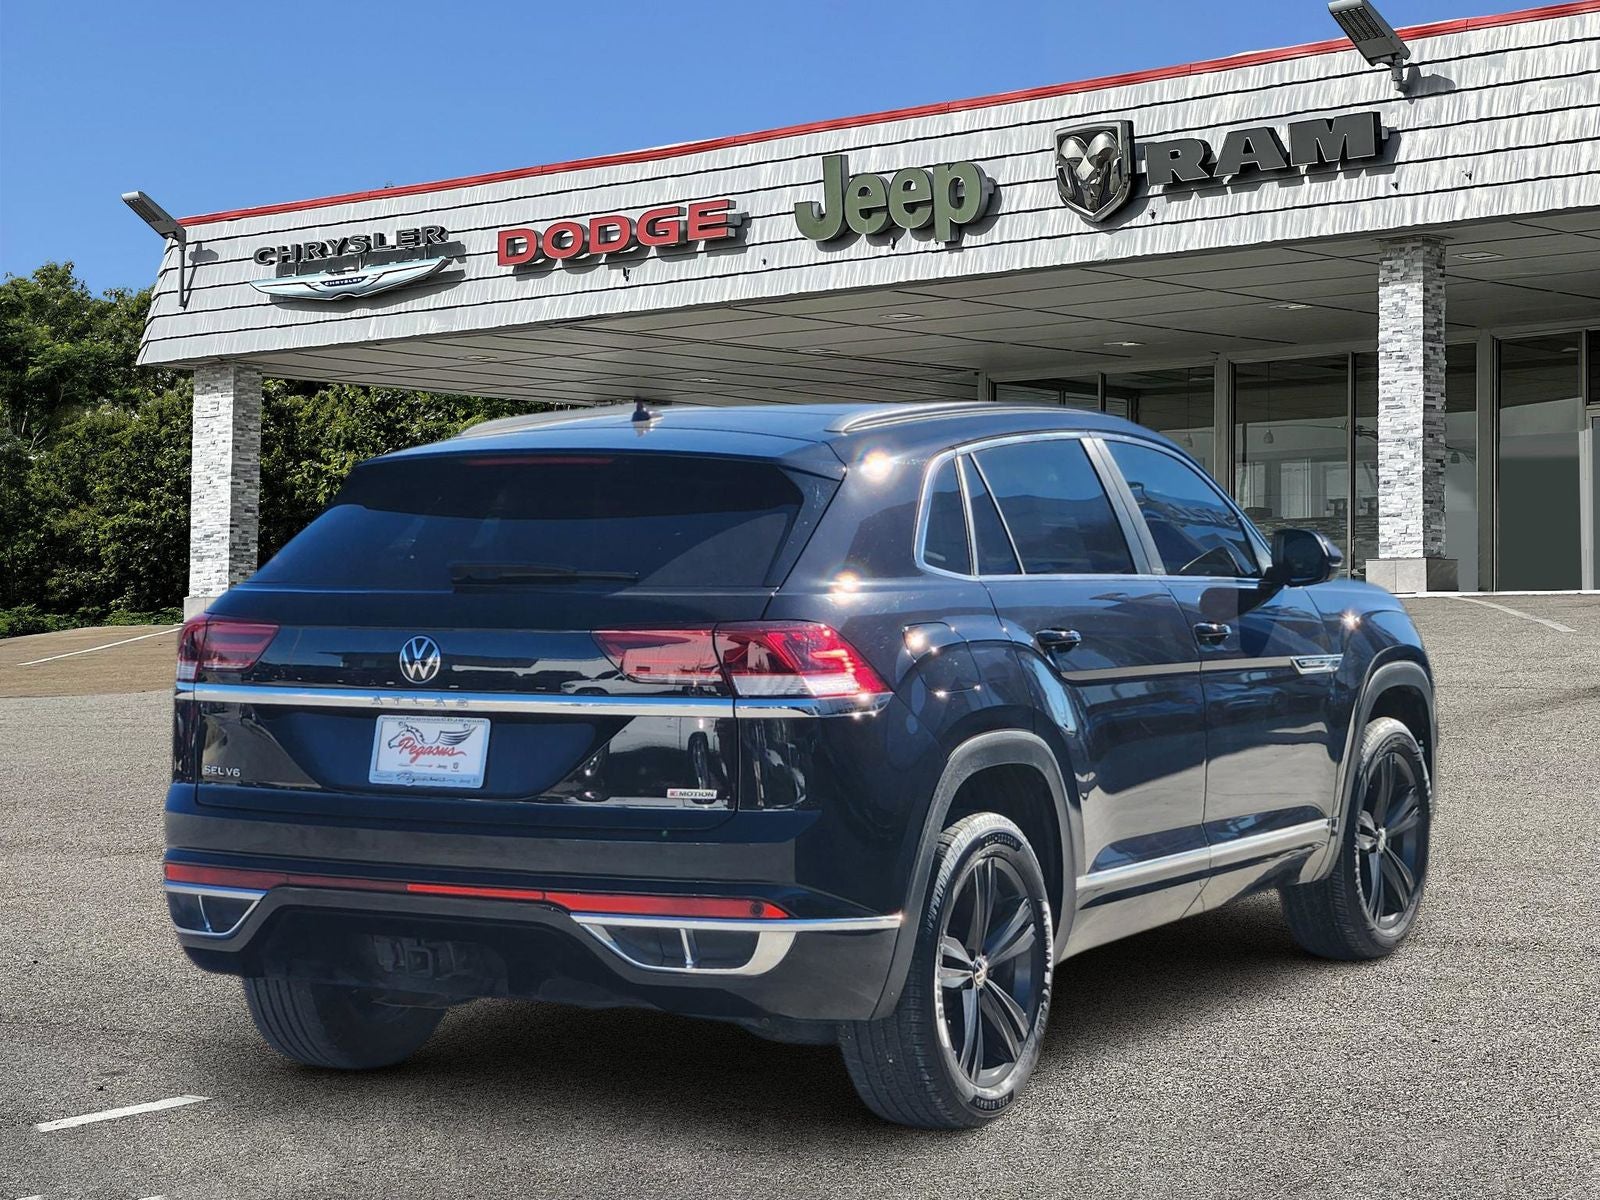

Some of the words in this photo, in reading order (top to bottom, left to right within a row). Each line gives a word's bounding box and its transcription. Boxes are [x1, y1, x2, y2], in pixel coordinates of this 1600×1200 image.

[1145, 111, 1382, 187] RAM
[794, 154, 989, 243] Jeep
[253, 225, 449, 267] CHRYSLER
[497, 199, 737, 268] DODGE
[324, 277, 363, 287] CHRYSLER
[371, 695, 469, 708] ATLAS
[398, 736, 467, 763] Pegasus
[204, 765, 225, 775] SEL
[225, 767, 241, 777] V6
